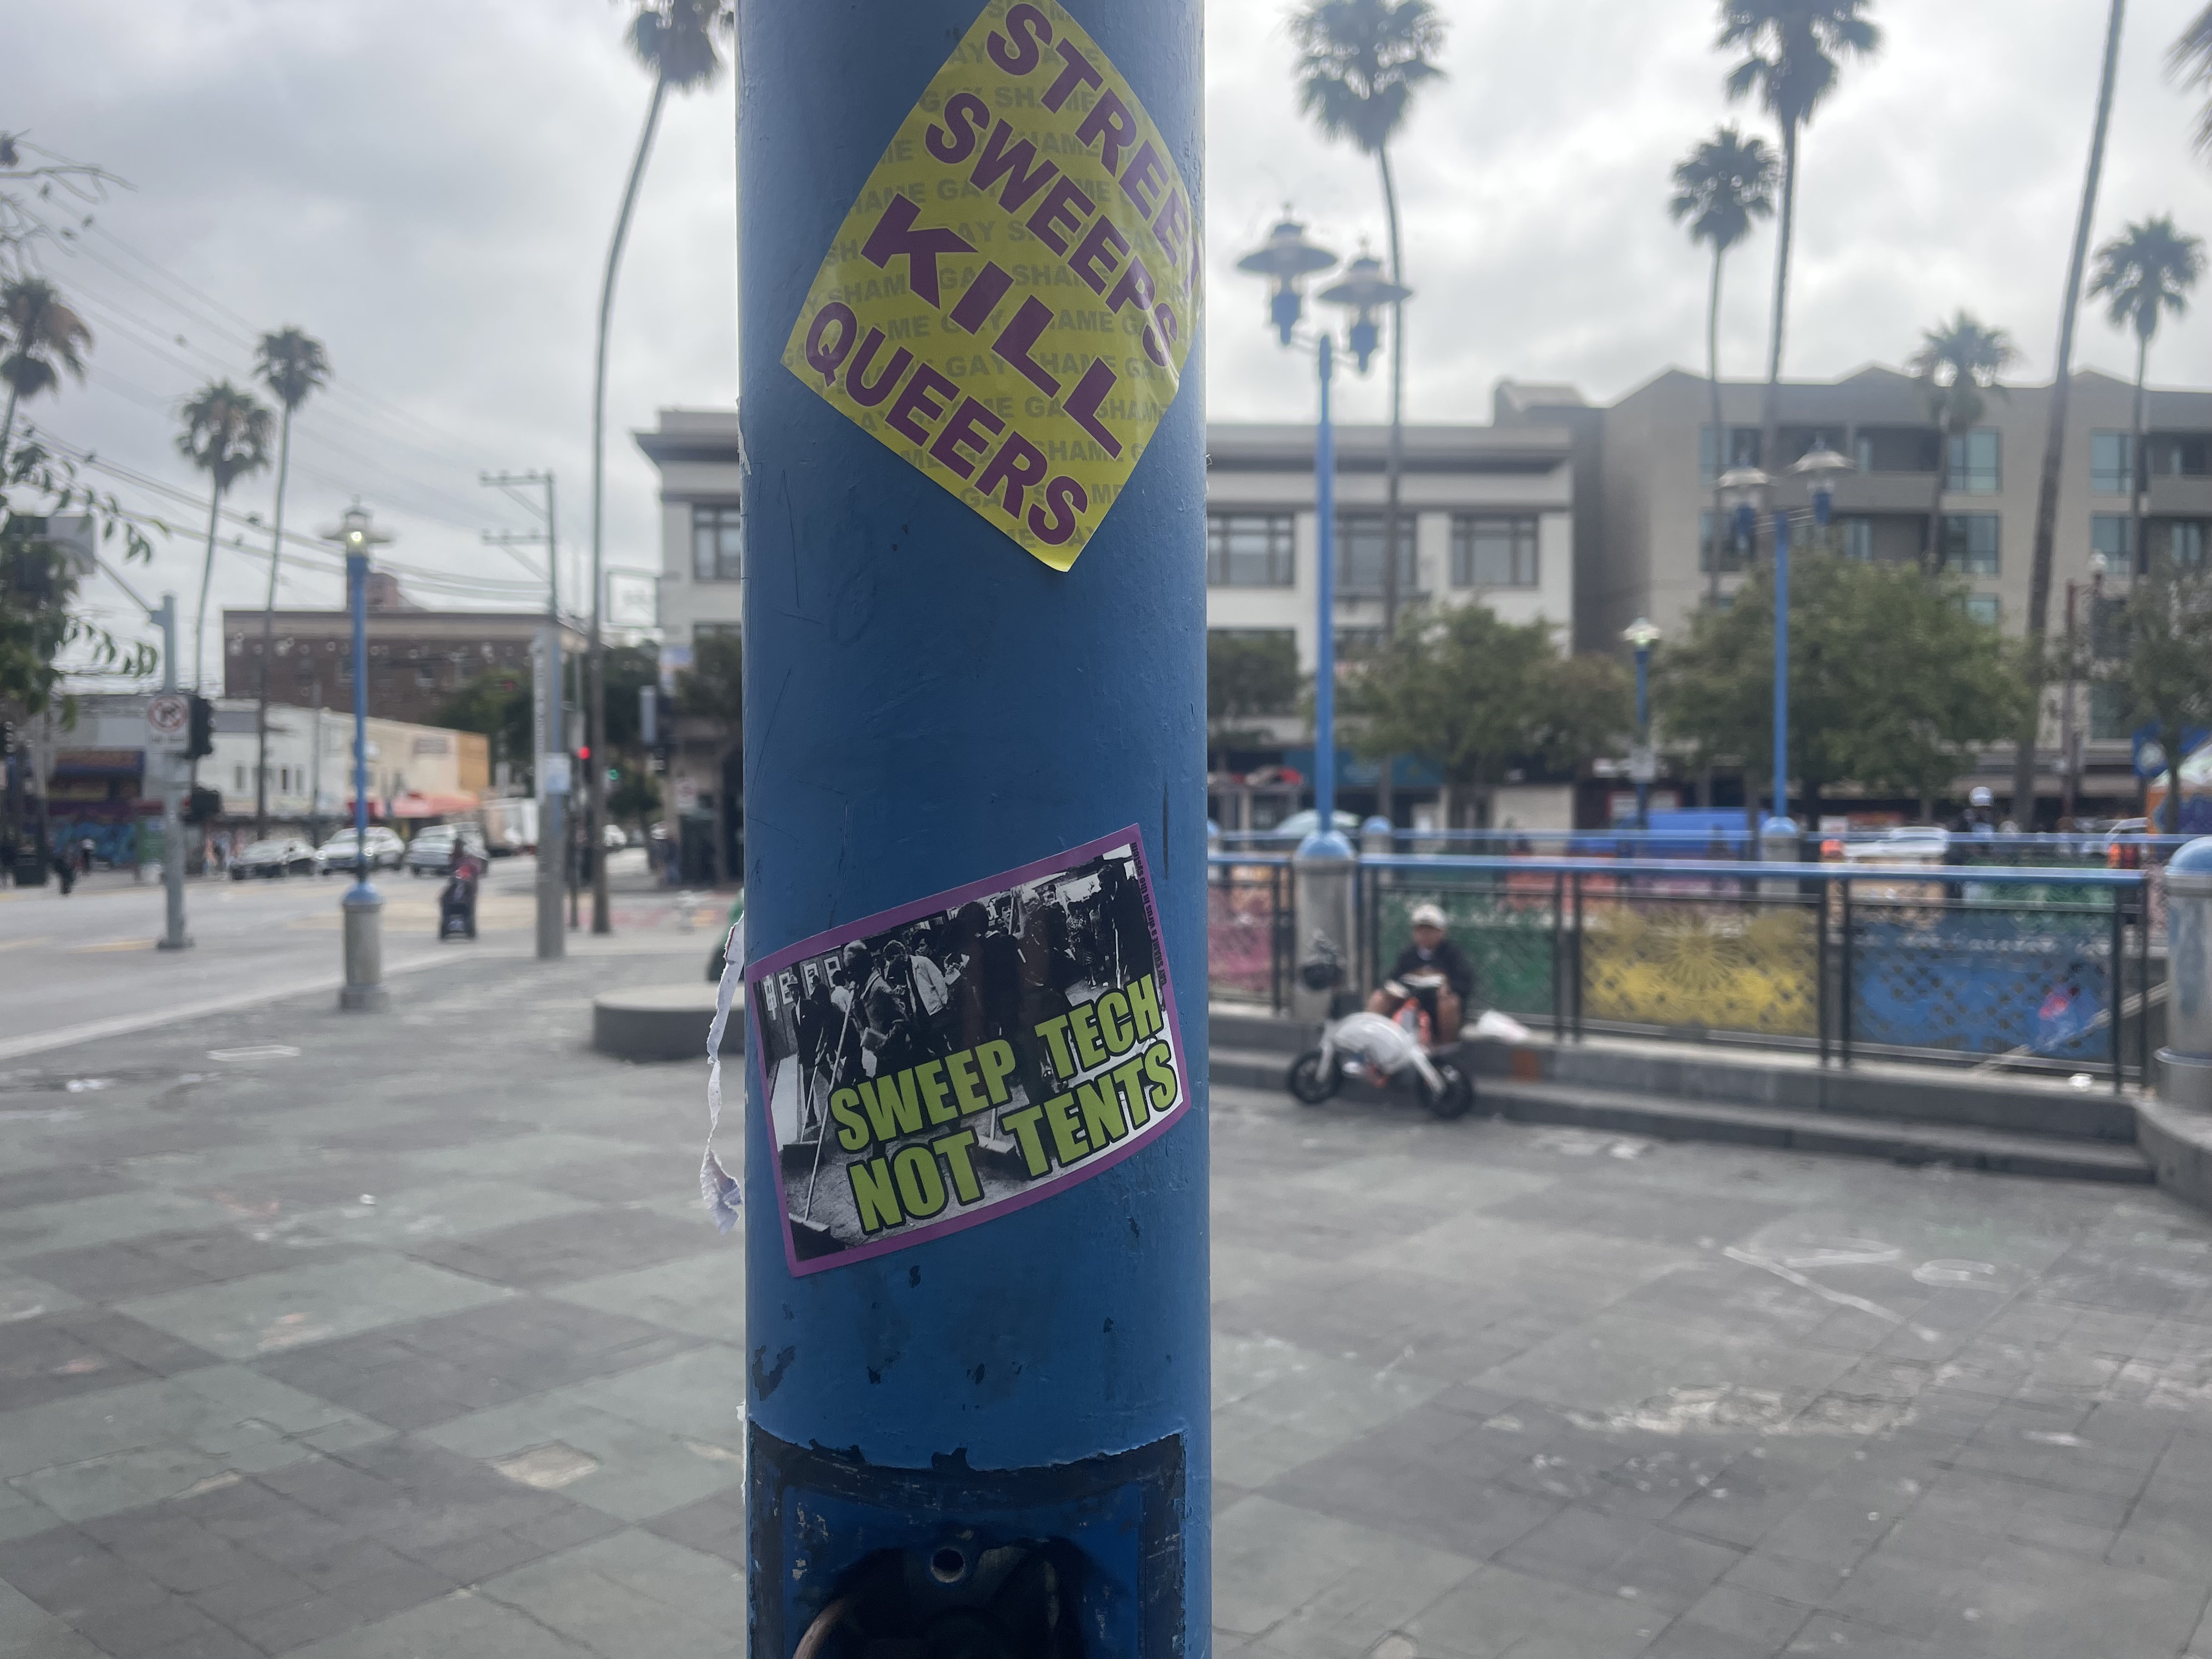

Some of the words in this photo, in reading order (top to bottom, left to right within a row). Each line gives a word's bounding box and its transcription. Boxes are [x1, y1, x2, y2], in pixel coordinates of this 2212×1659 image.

[925, 93, 1178, 367] SWEEPS
[987, 3, 1200, 298] STREET
[860, 193, 1122, 460] KILL
[805, 302, 1088, 545] QUEERS
[1131, 842, 1144, 877] system
[1139, 877, 1148, 894] the
[1143, 893, 1150, 905] in
[1146, 904, 1155, 930] virus
[1152, 935, 1164, 969] SHAME
[829, 1039, 1017, 1153] SWEEP
[1035, 974, 1165, 1079] TECH
[849, 1127, 985, 1234] NOT
[1002, 1041, 1178, 1178] TENTS
